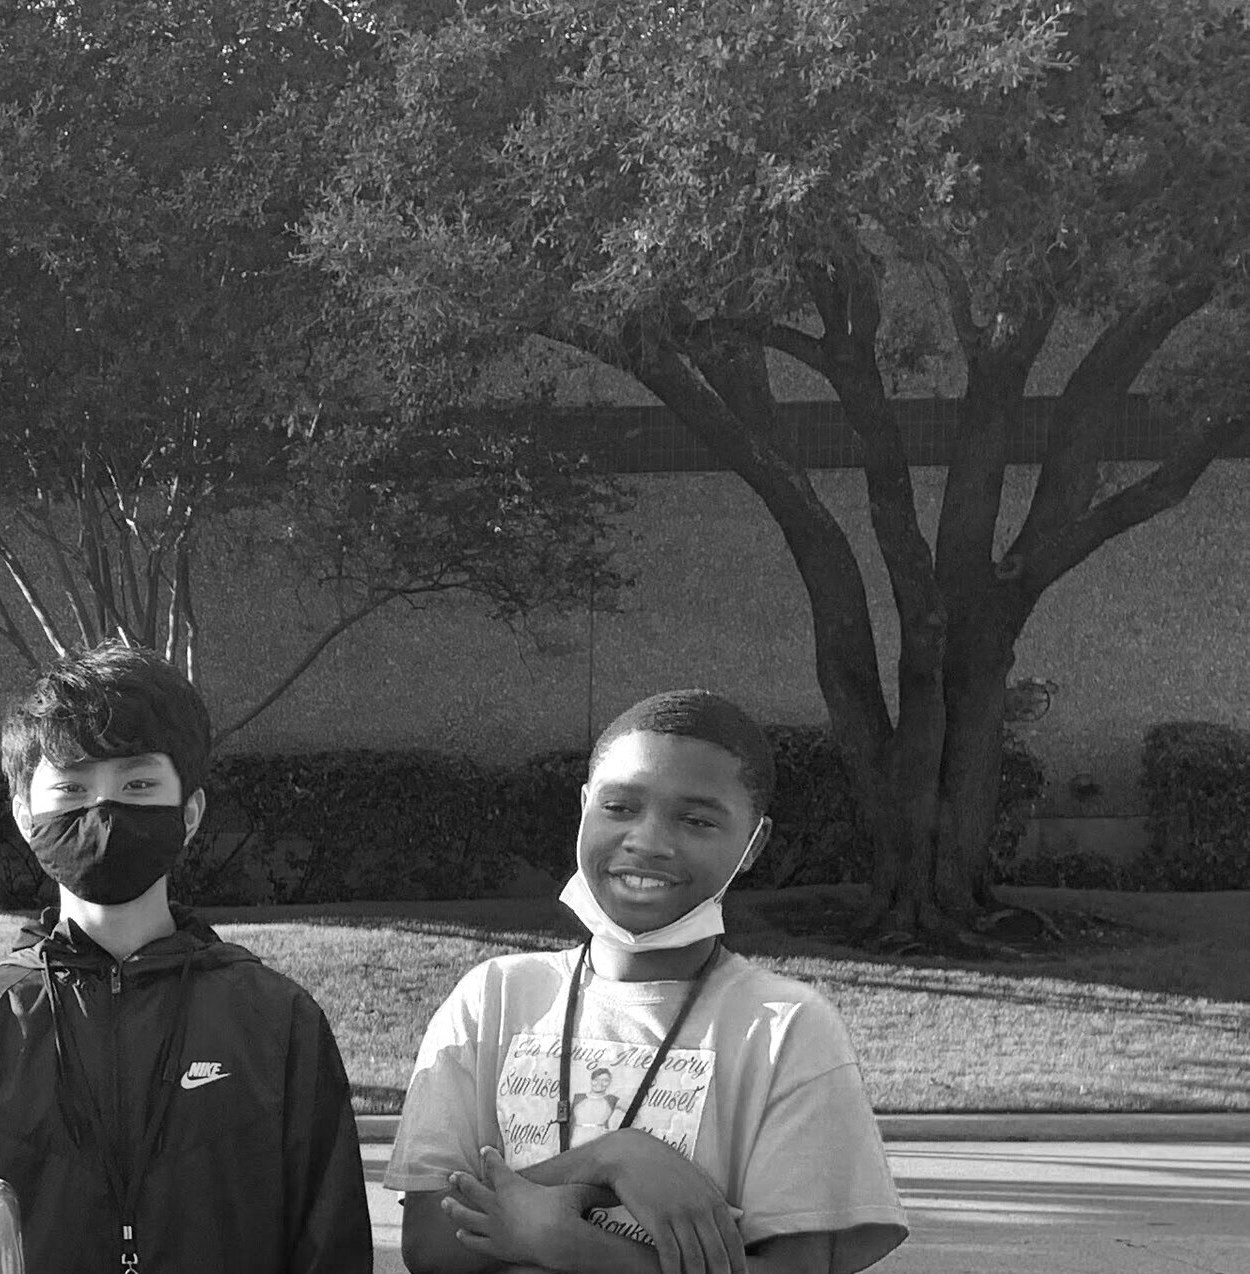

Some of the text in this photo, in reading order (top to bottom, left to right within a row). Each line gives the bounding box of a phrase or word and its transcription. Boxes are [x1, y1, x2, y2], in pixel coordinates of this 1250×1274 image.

[188, 1061, 223, 1078] NIKE
[499, 1066, 561, 1099] Sunrise
[641, 1076, 705, 1114] unset
